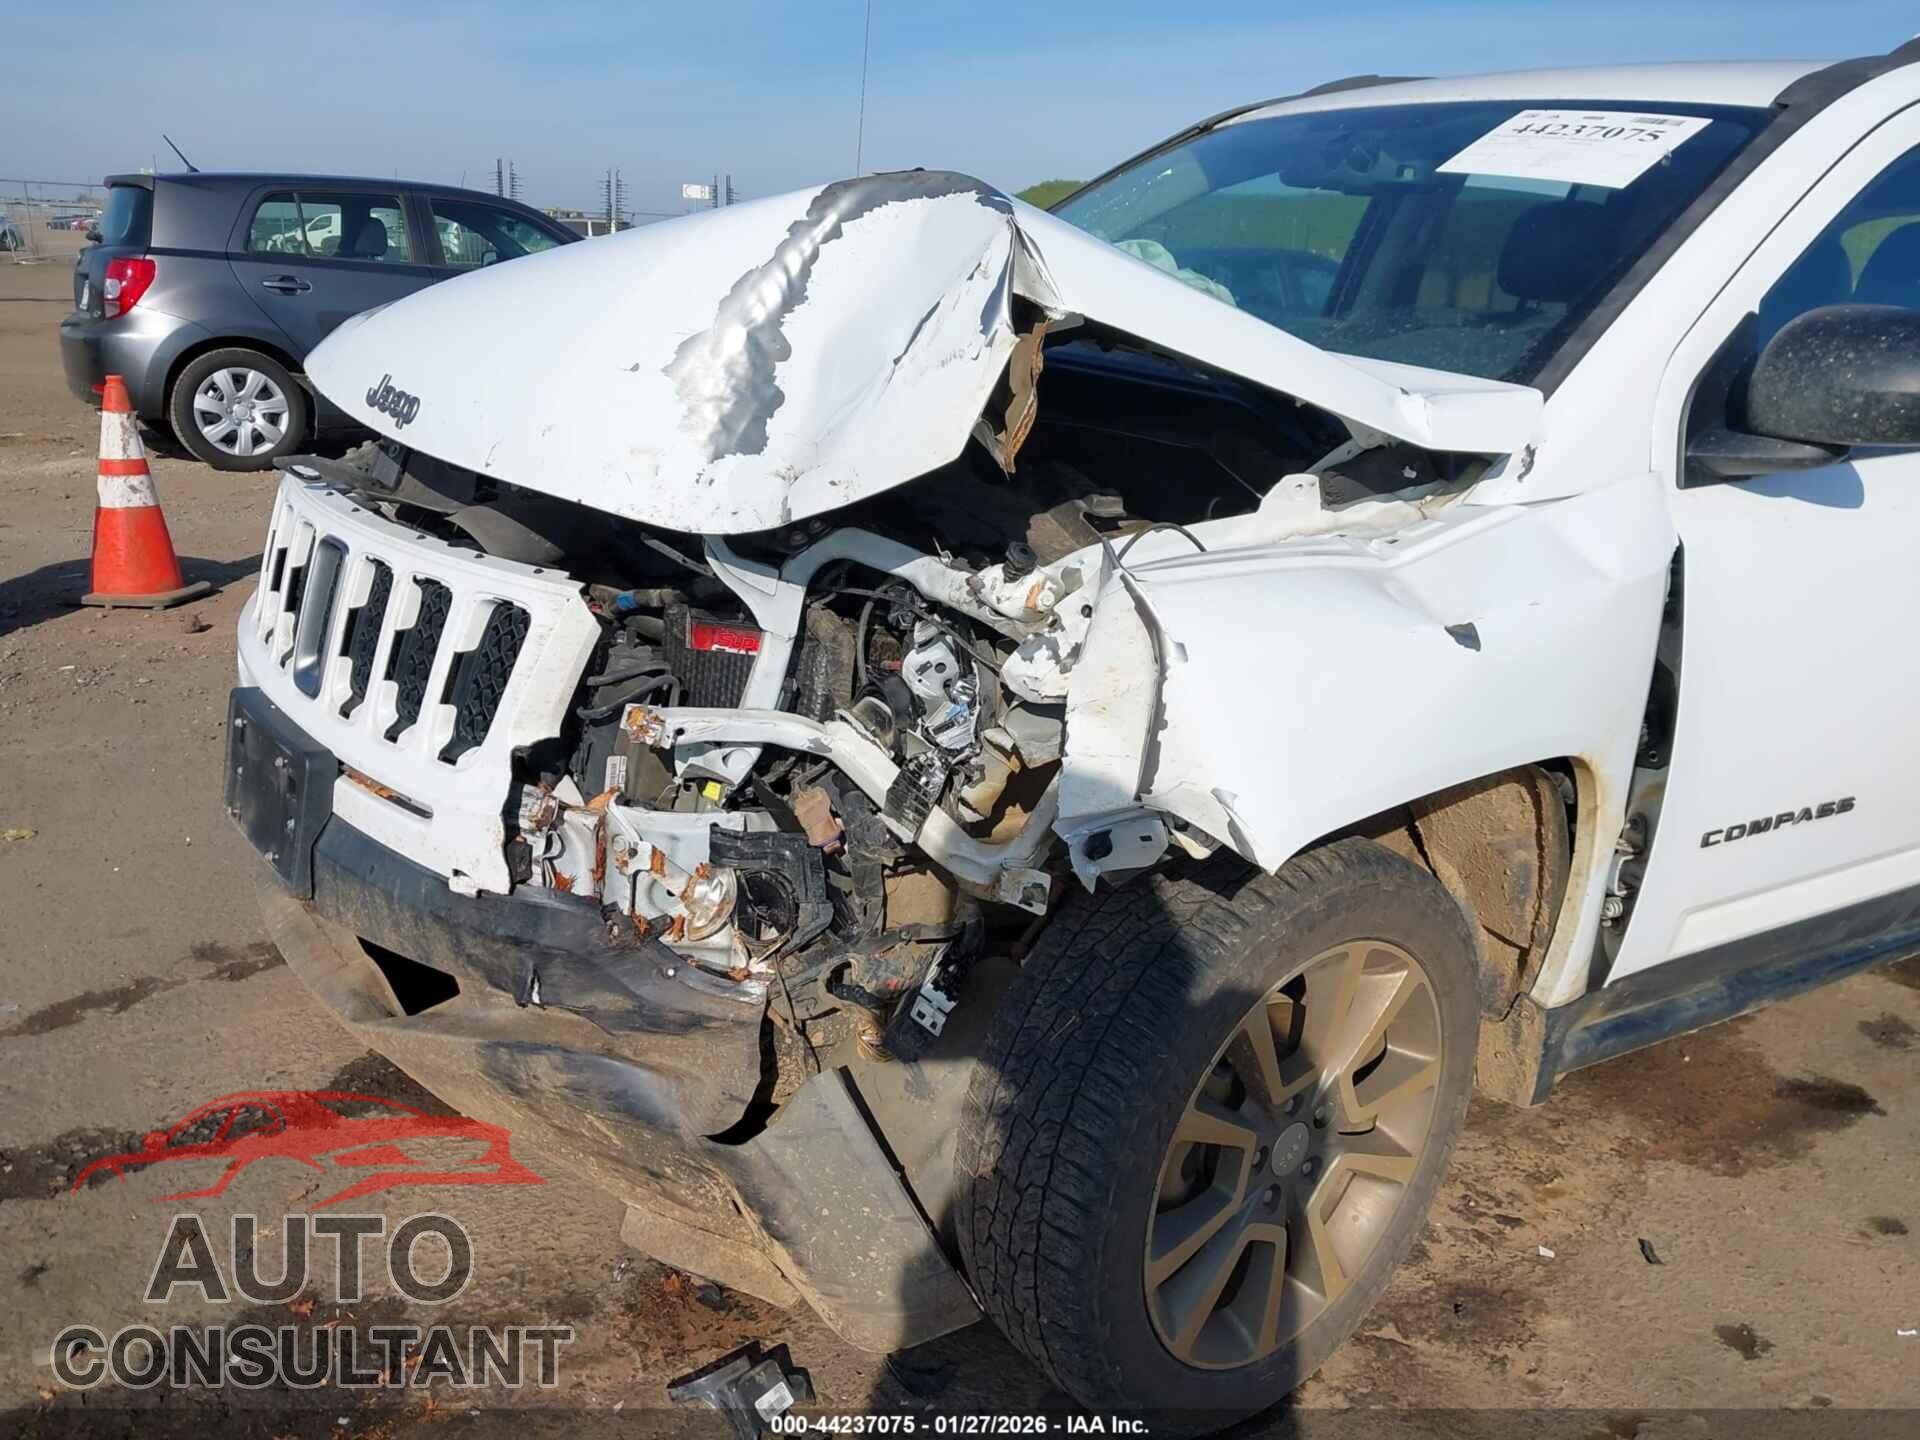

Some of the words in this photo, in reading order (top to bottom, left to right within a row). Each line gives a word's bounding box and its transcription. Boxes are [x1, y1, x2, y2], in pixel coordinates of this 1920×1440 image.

[1512, 122, 1668, 142] 44237075
[366, 373, 420, 430] Jeep
[1700, 796, 1856, 848] COMPASS
